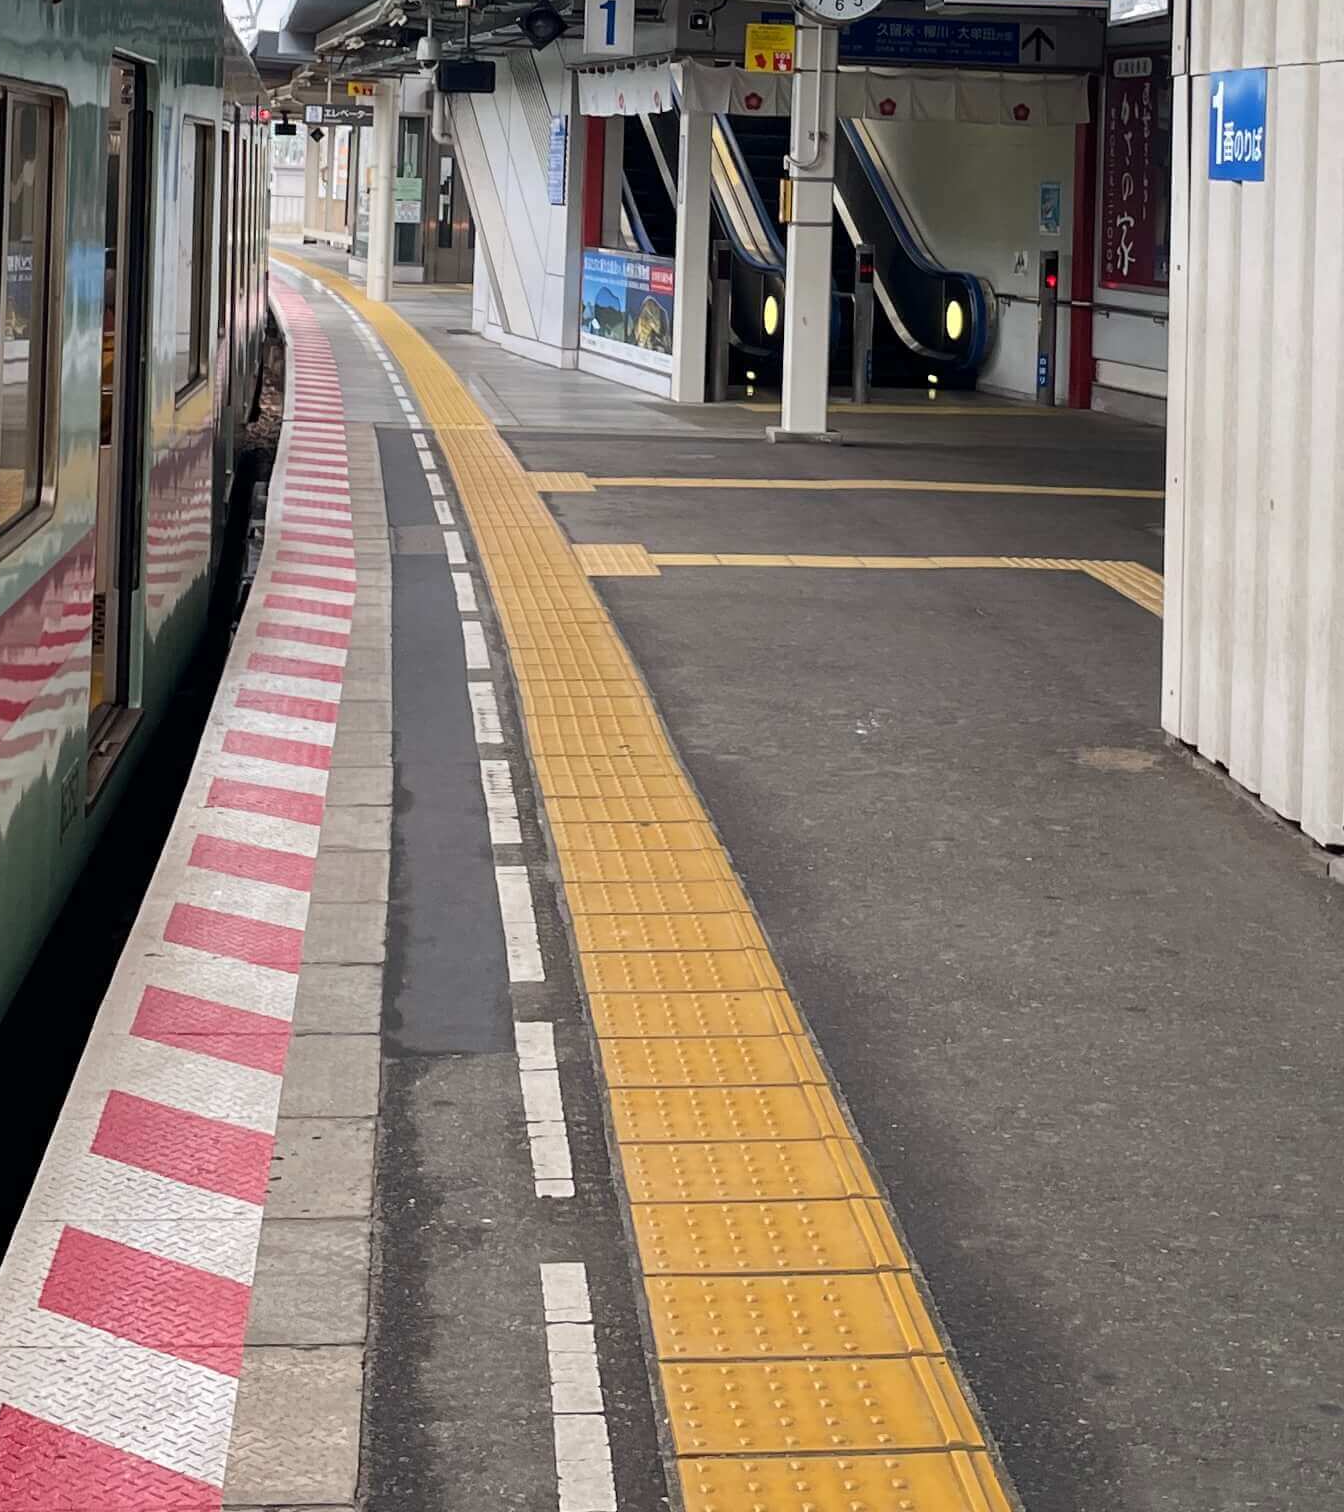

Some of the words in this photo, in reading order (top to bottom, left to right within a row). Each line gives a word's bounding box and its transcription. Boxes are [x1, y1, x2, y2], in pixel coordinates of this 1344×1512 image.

[835, 0, 844, 11] 6
[599, 0, 616, 46] 1
[324, 108, 373, 119] エレベーター
